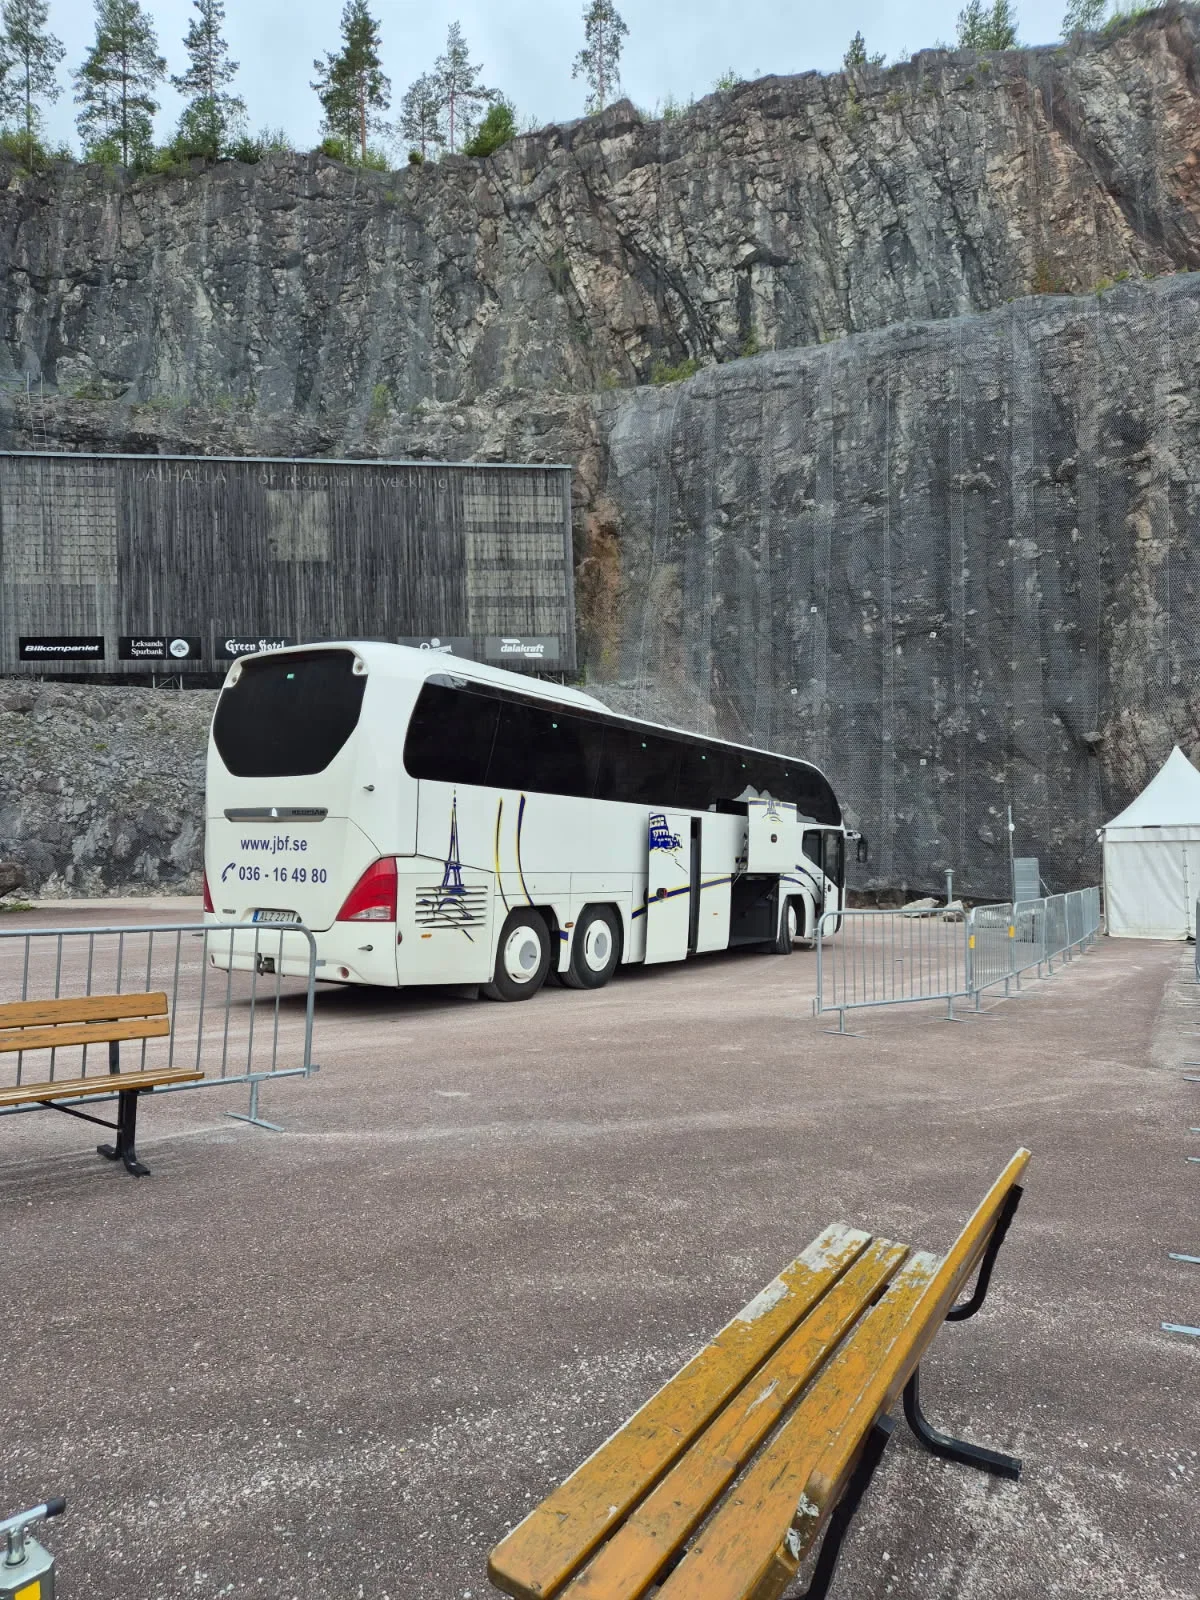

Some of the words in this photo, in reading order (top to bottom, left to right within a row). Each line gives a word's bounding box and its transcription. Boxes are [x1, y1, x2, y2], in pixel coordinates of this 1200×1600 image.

[131, 639, 164, 647] Leksands
[225, 639, 256, 654] Green
[258, 639, 285, 652] Hotel
[25, 645, 99, 653] Bilkompaniet
[131, 648, 164, 656] Sparbank
[500, 644, 544, 653] dalakraft
[240, 836, 308, 854] www.jbf.se
[239, 866, 260, 881] 036
[273, 867, 287, 882] 16
[291, 868, 307, 882] 49
[311, 868, 327, 883] 80
